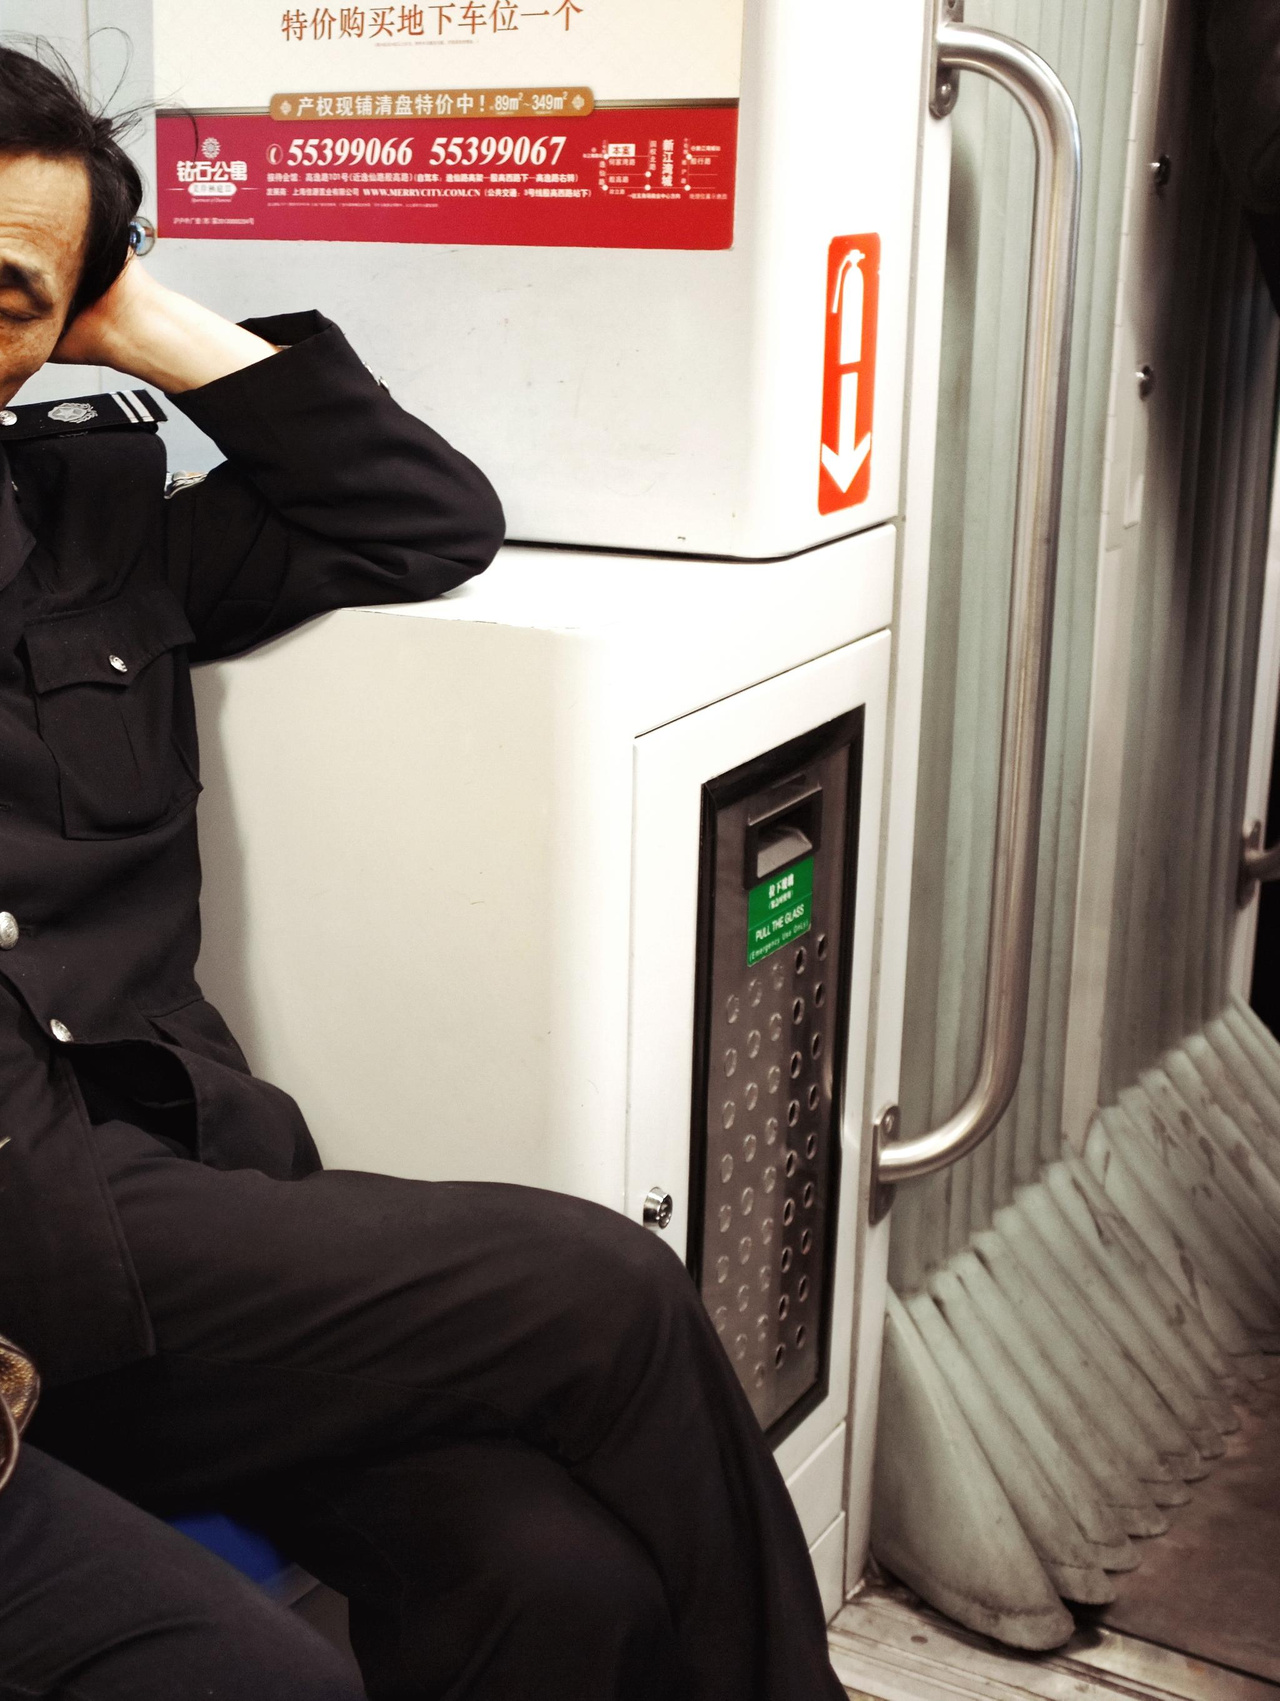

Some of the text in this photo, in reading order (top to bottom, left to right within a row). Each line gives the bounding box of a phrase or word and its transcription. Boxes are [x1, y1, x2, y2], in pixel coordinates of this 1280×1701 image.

[281, 0, 584, 41] 特价购买地下车位一个
[286, 137, 415, 167] 55399066
[428, 136, 567, 166] 55399067
[661, 139, 674, 187] 新江湾城
[176, 160, 248, 182] 钻石公寓
[362, 188, 481, 197] WWW.MERRYCITY.COM.CN
[755, 903, 805, 942] PULL THE GLASS
